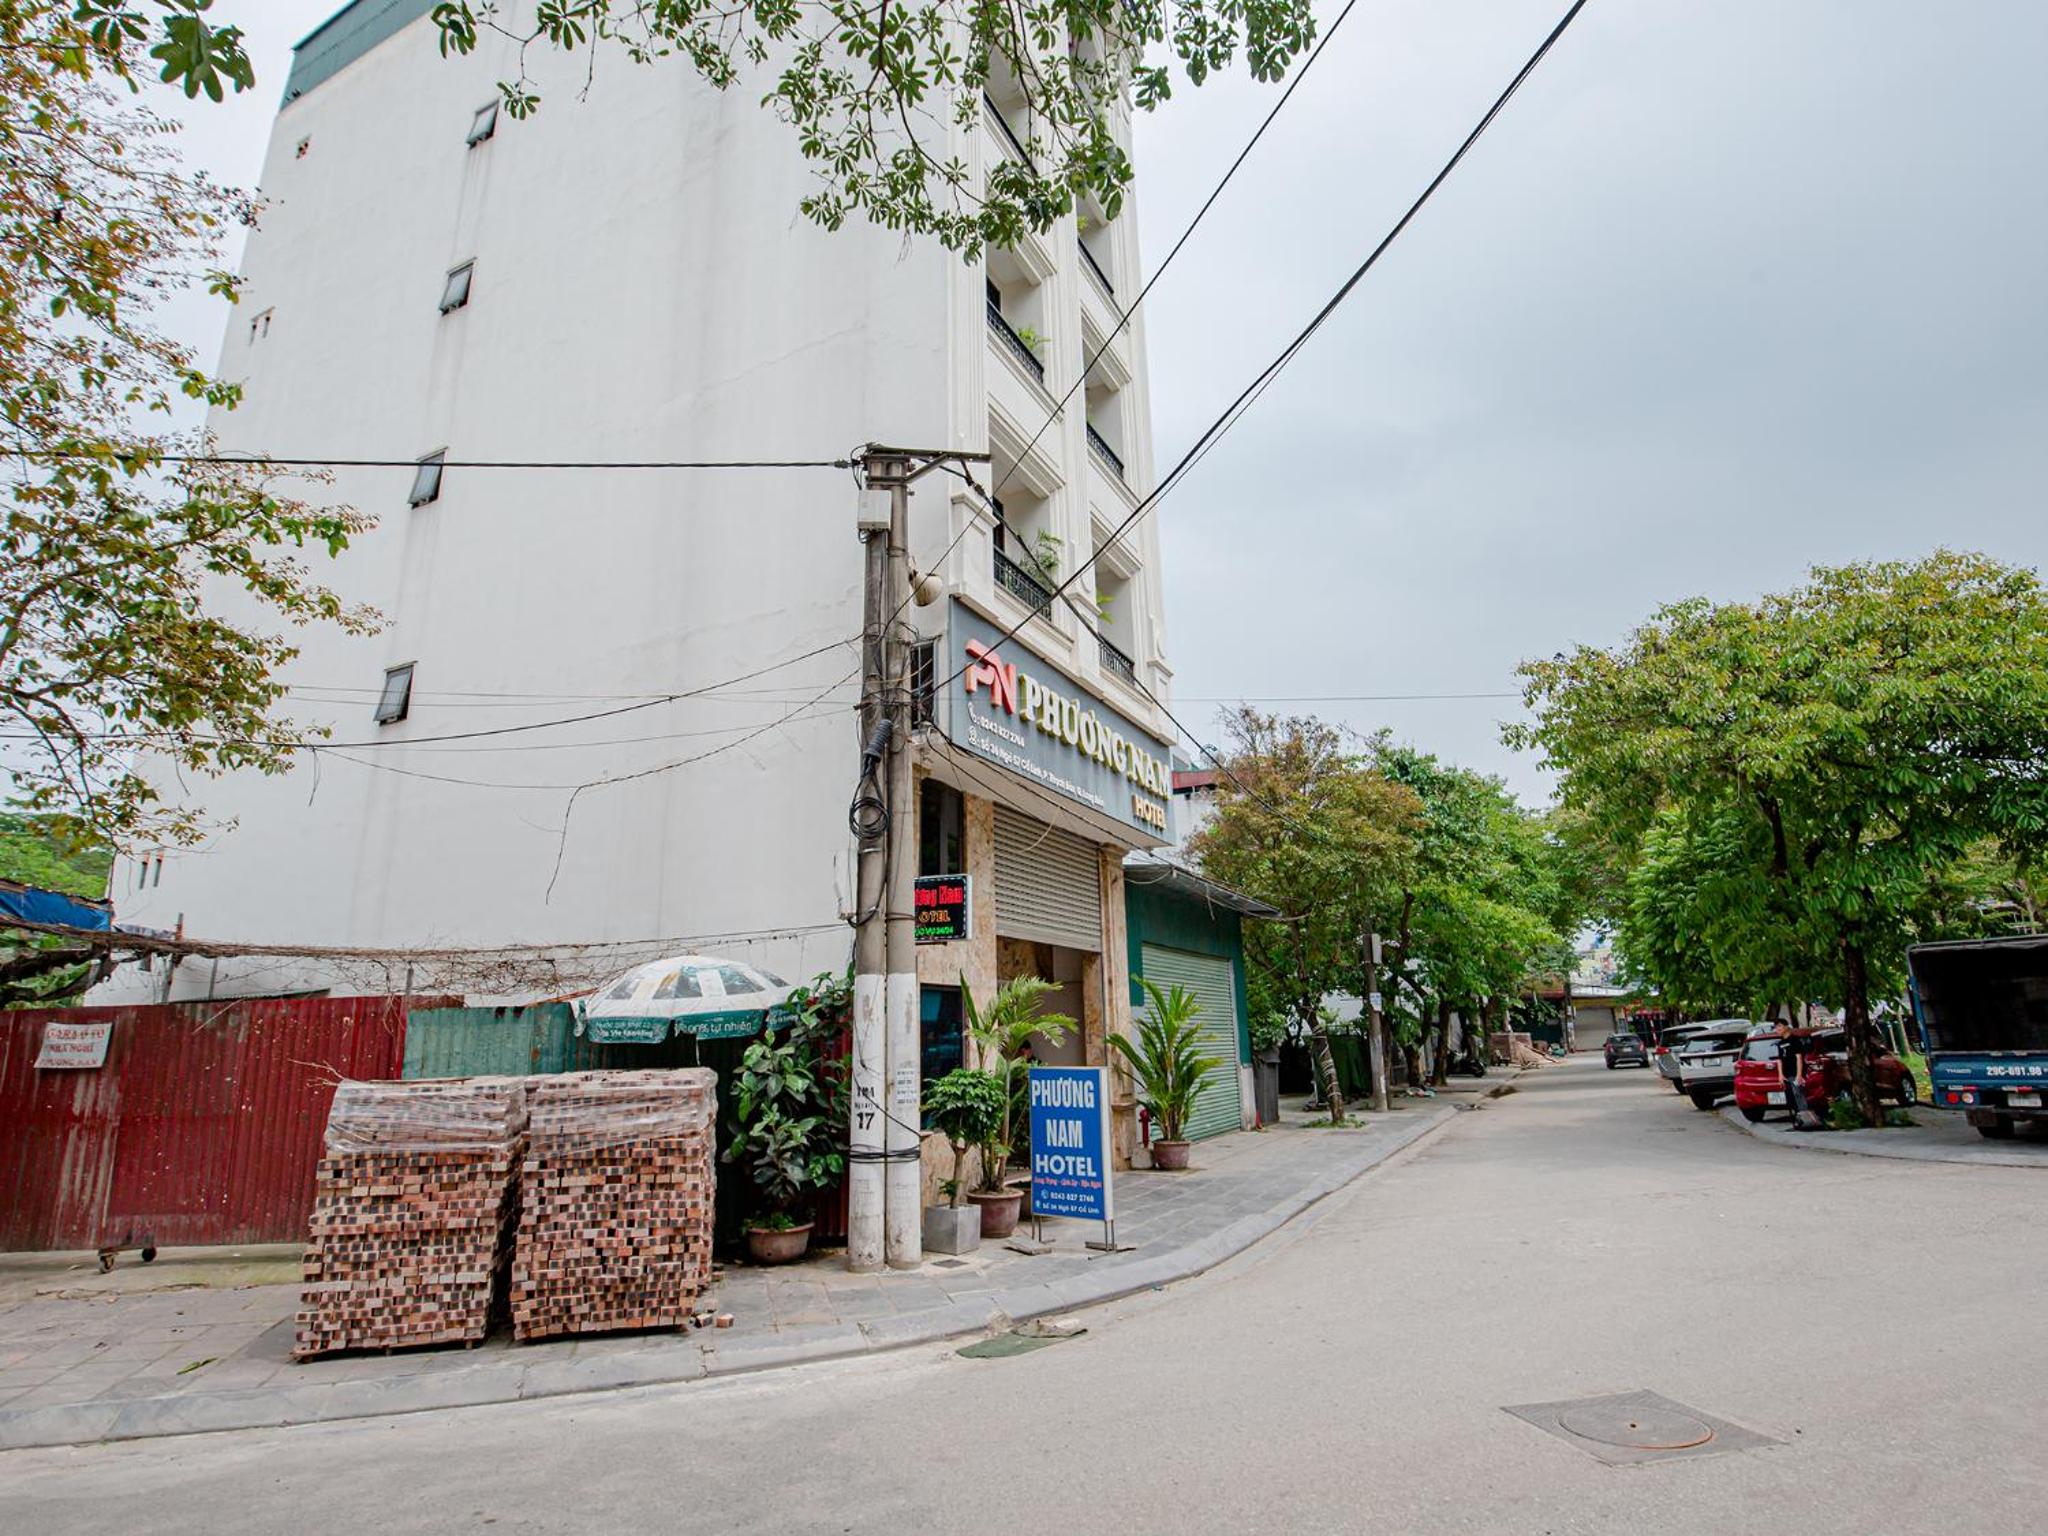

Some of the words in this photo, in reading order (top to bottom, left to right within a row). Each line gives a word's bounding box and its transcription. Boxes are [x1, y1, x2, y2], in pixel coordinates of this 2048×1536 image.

[1019, 672, 1127, 775] PHƯƠNG
[1125, 741, 1173, 801] NAM
[1131, 793, 1168, 831] HOTEL
[918, 909, 951, 923] OTEL
[1031, 1076, 1095, 1109] PHƯƠNG
[856, 1112, 874, 1131] 17
[1046, 1119, 1083, 1149] NAM
[1035, 1154, 1097, 1177] HOTEL
